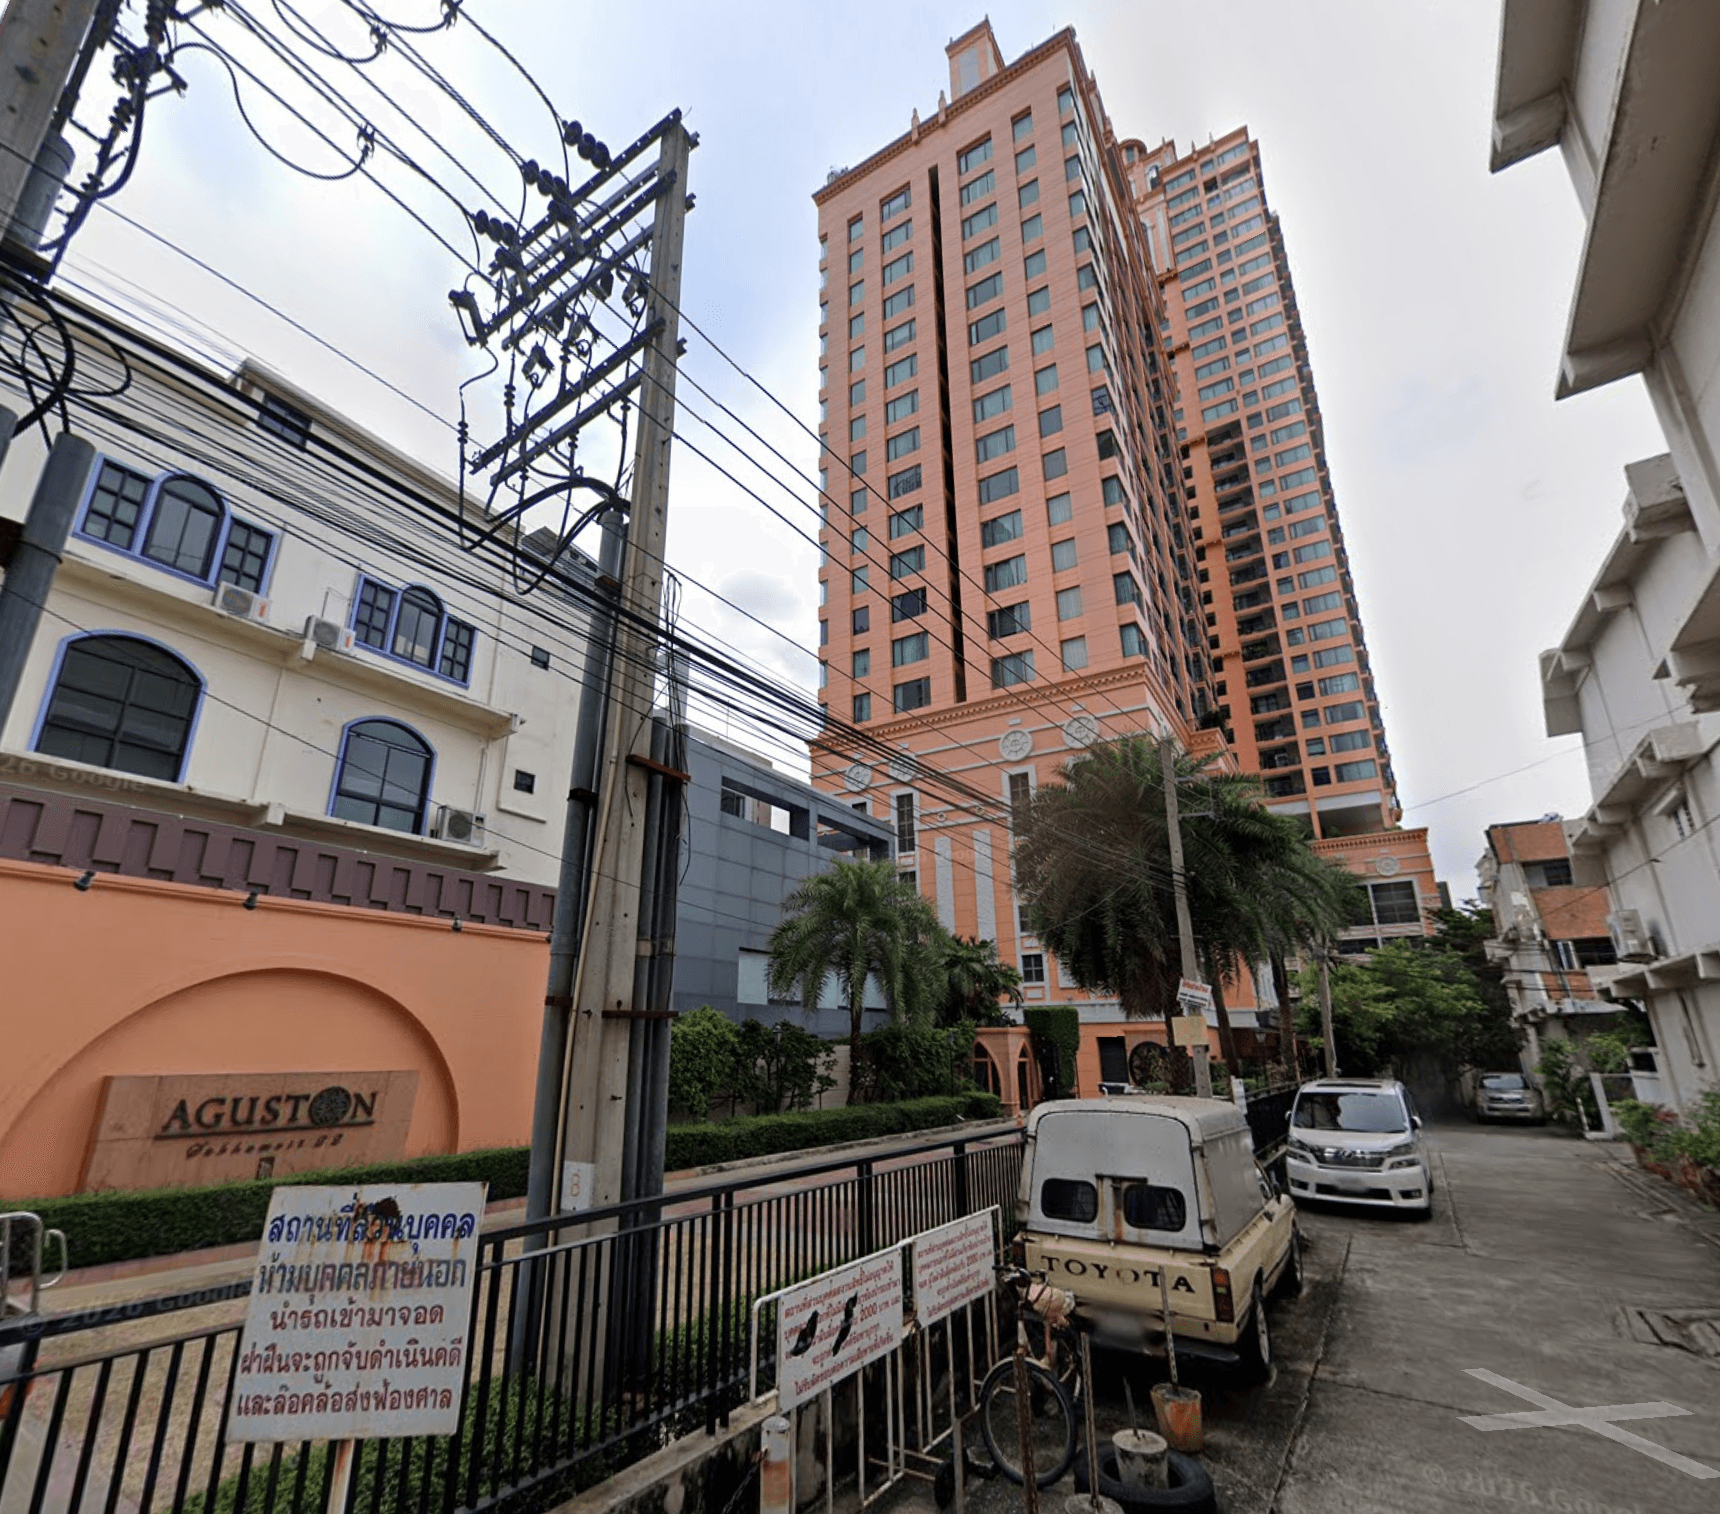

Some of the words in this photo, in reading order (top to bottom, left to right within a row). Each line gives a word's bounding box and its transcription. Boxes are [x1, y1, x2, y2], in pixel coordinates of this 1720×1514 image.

[161, 1085, 379, 1133] AGUSTON
[270, 1296, 445, 1331] นำรถเข้ามาจอด
